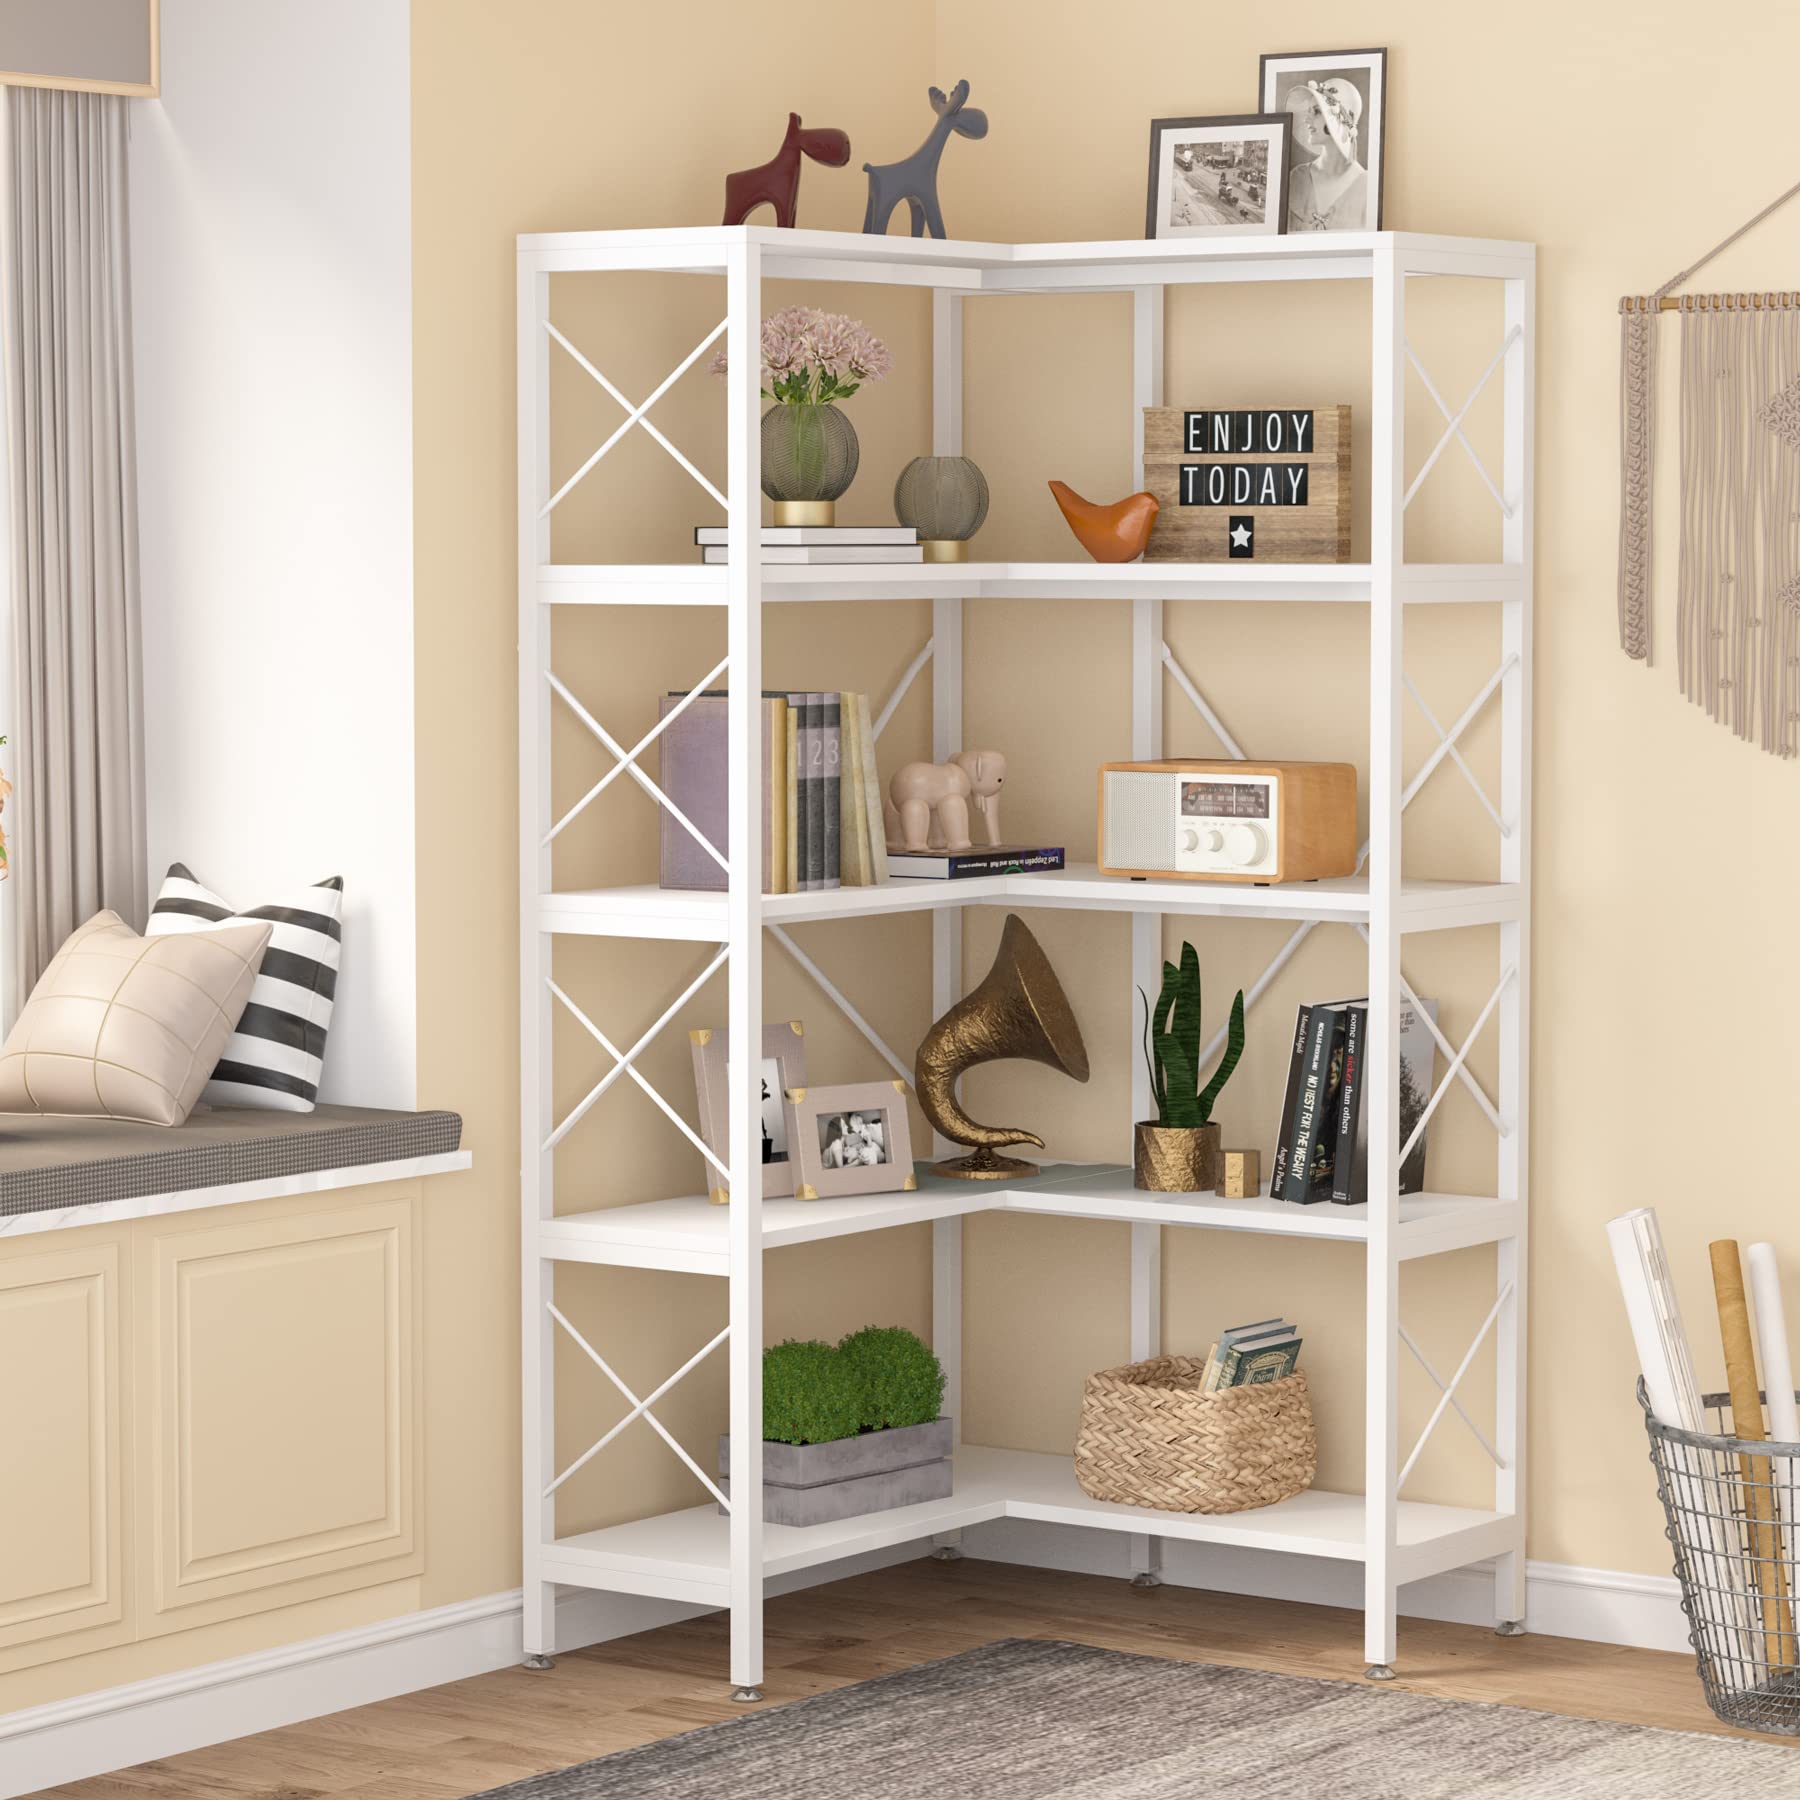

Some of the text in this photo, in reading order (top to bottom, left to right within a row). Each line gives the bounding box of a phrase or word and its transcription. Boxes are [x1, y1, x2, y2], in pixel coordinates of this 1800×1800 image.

[1189, 412, 1309, 452] ENJOY
[1183, 465, 1304, 505] TODAY
[813, 740, 822, 765] 2
[829, 739, 839, 764] 3
[1024, 857, 1047, 866] Zeppelin
[1349, 1013, 1358, 1038] some
[1345, 1055, 1354, 1084] sicker
[1343, 1085, 1352, 1105] than
[1291, 1074, 1319, 1180] NO REST FOR THE WEARY
[1341, 1106, 1351, 1135] others
